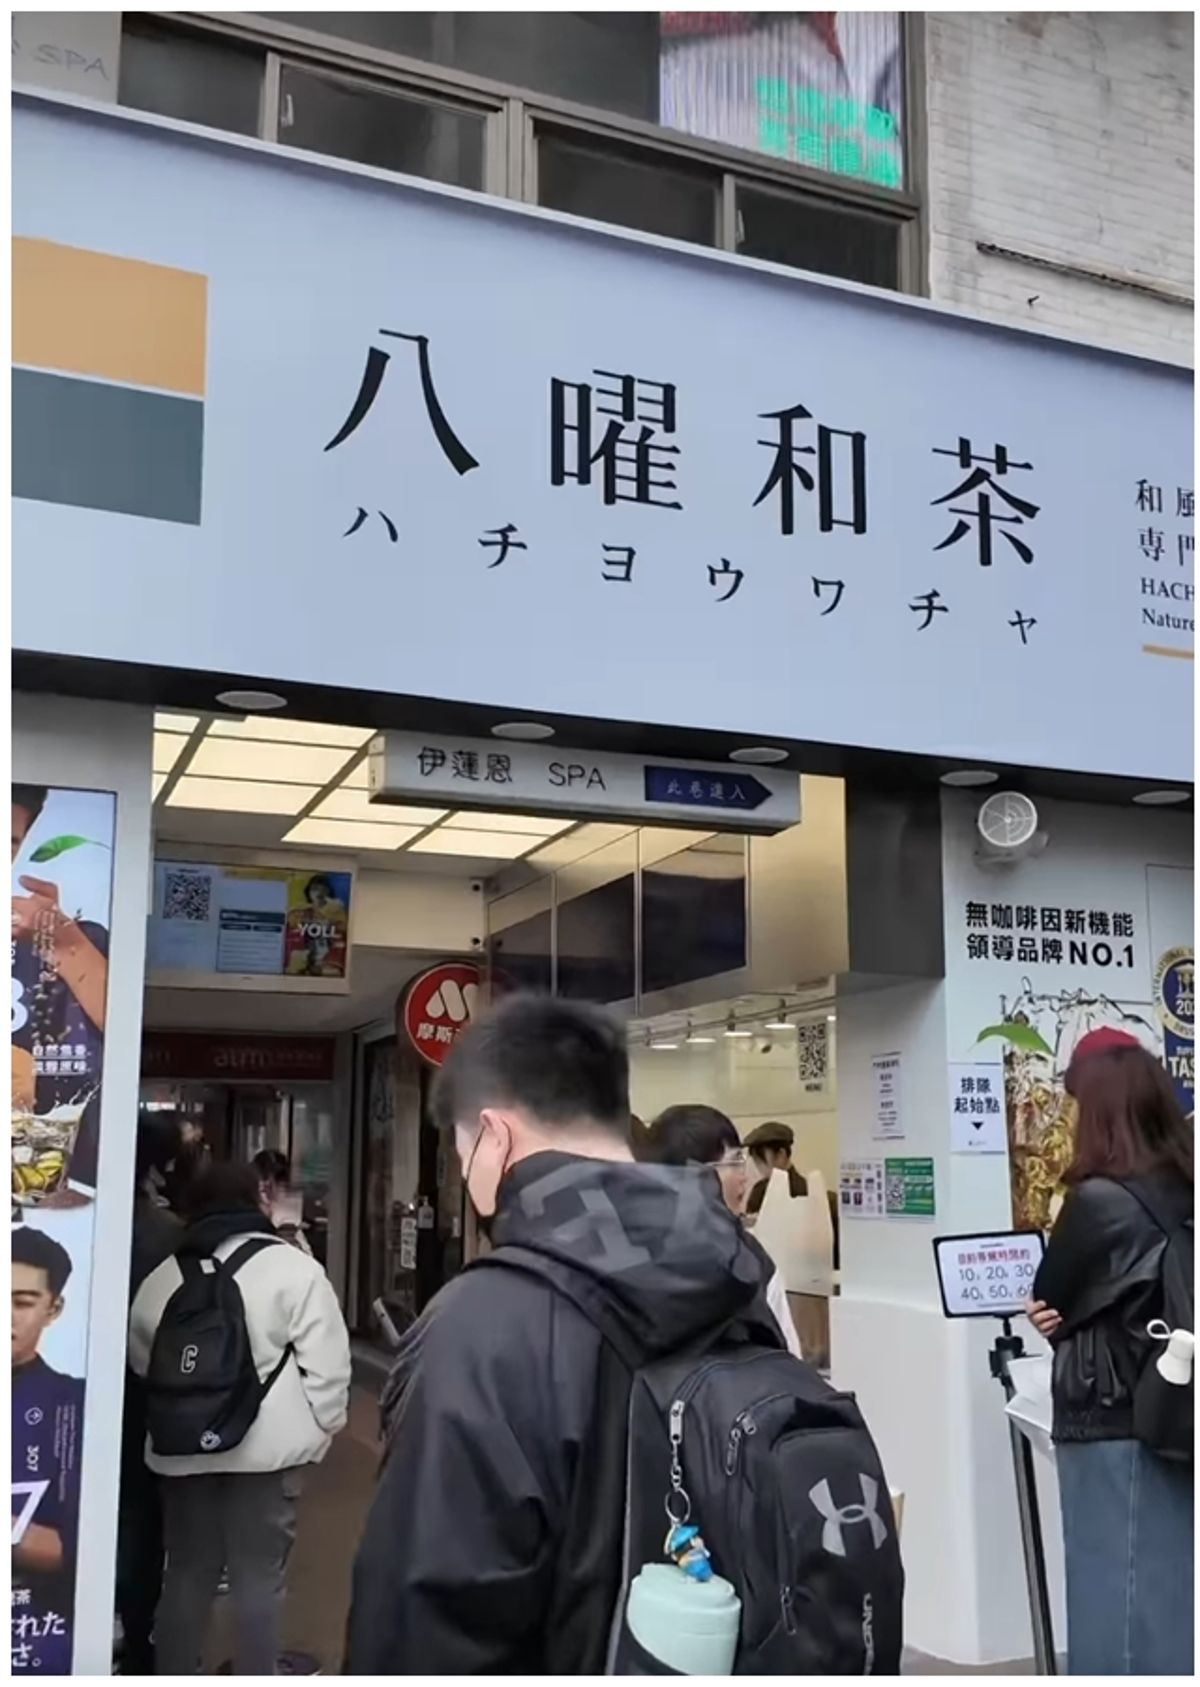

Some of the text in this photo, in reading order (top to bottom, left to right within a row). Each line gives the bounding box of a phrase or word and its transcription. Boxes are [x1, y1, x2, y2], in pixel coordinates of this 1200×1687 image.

[33, 43, 110, 81] SPA
[323, 327, 1042, 567] 八曜和茶
[417, 746, 607, 791] 伊蓮恩 SPA
[965, 901, 1134, 938] 無咖啡因新機能
[1175, 999, 1195, 1016] 20
[416, 1022, 461, 1044] 摩斯
[961, 1076, 991, 1094] 排隊
[954, 1096, 1001, 1114] 起始點
[12, 1611, 66, 1639] れた
